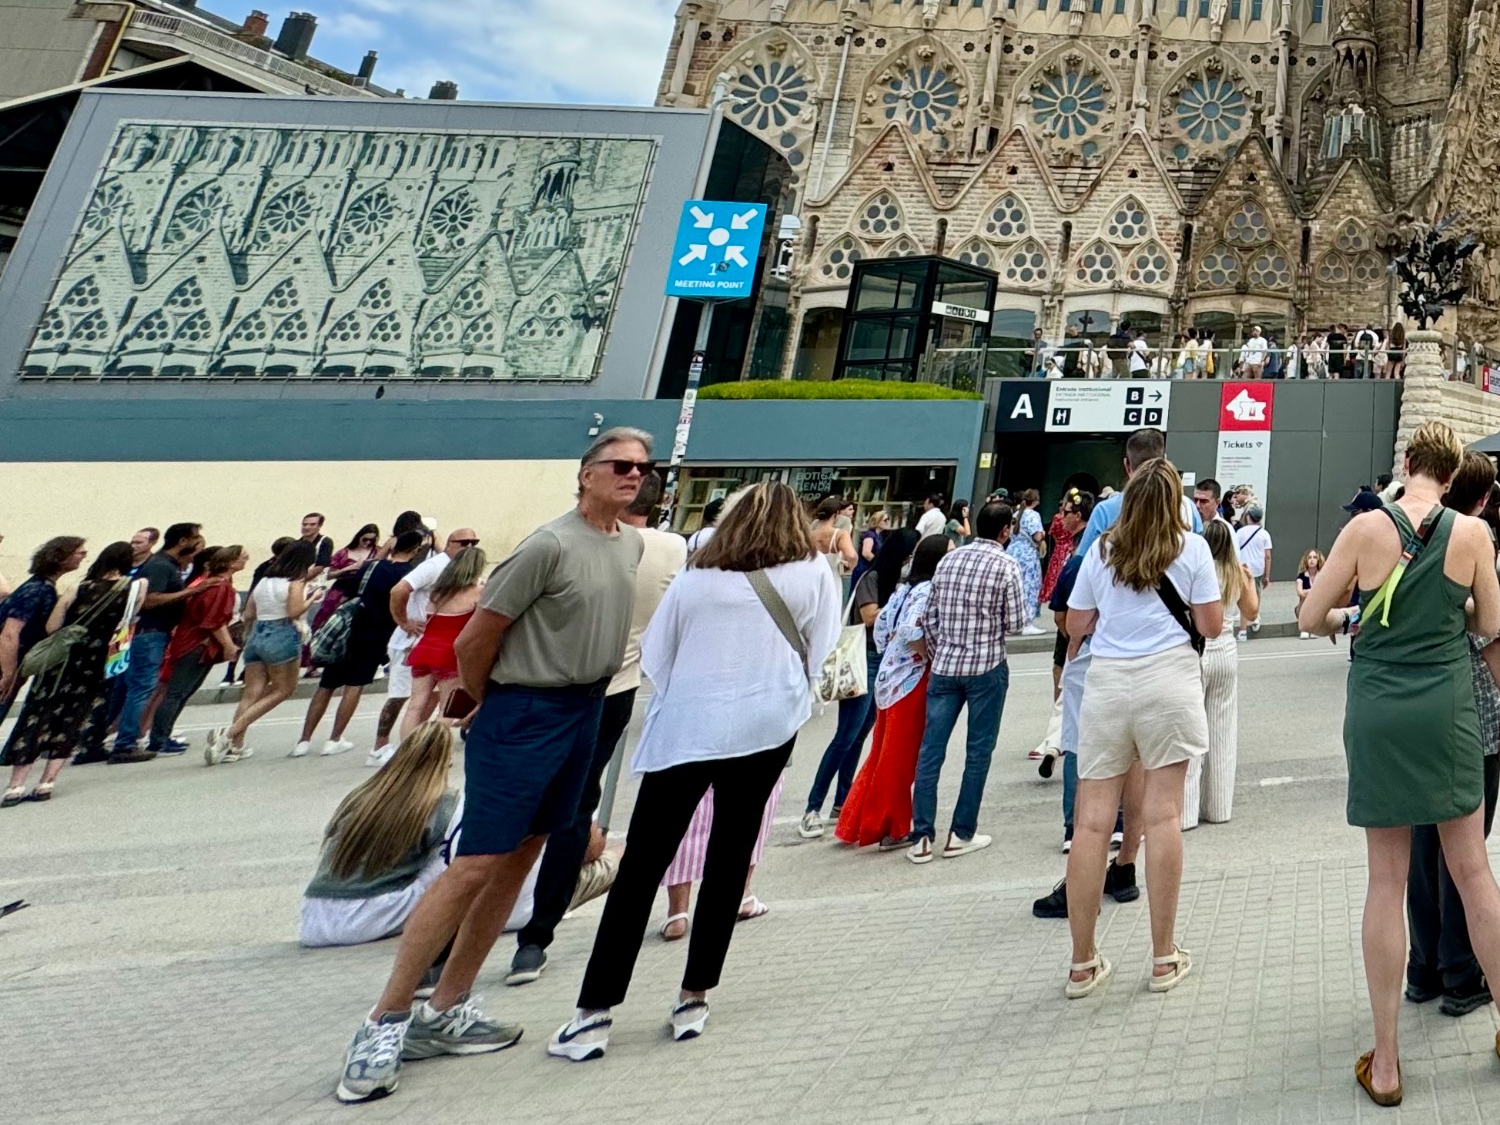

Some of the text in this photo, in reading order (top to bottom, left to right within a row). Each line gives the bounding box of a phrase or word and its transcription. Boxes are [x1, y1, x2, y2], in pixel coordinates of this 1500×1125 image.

[674, 280, 745, 289] MEETING POINT
[1130, 391, 1139, 401] B
[1010, 393, 1034, 419] A
[1128, 412, 1138, 422] C
[1149, 412, 1158, 422] D
[1223, 440, 1254, 449] Tickets
